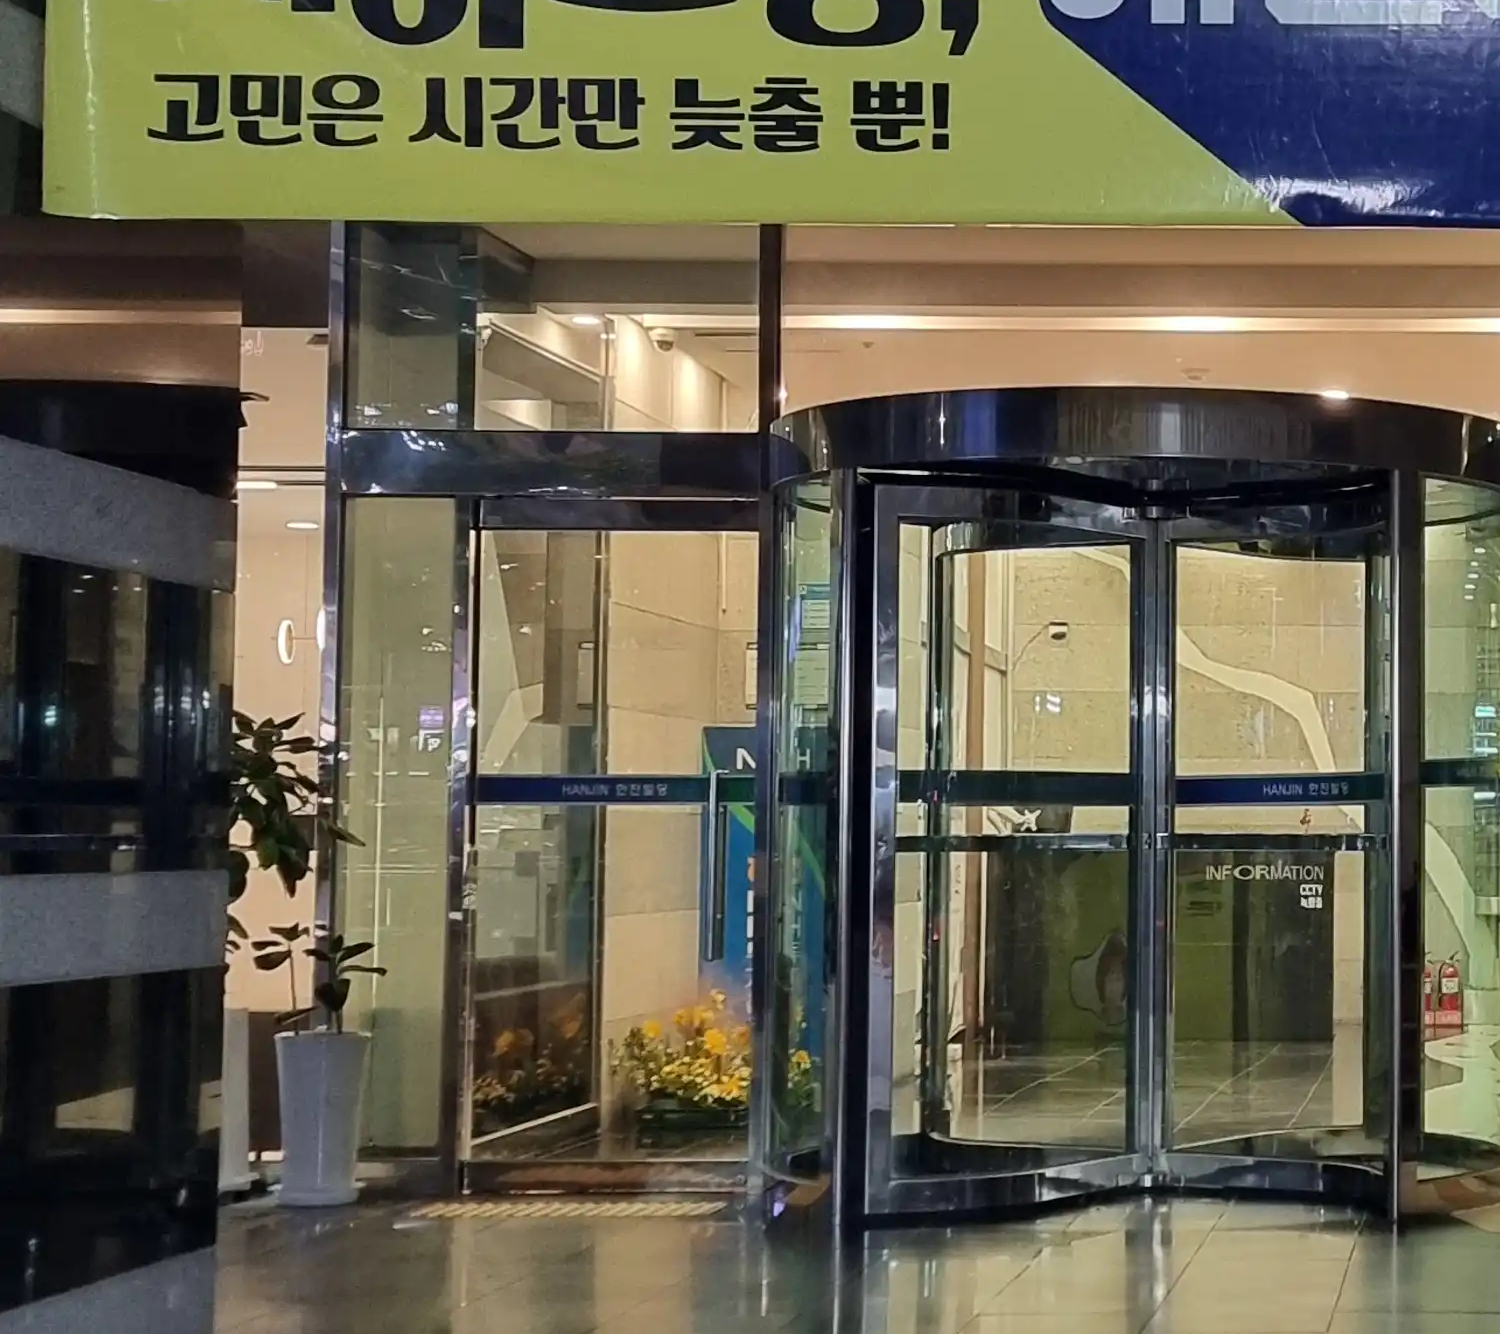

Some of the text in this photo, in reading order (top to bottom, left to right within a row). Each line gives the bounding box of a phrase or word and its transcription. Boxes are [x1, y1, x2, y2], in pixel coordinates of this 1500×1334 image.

[146, 73, 952, 153] 고민은 시간만 늦출 뿐!
[562, 784, 609, 798] HANJIN
[1263, 783, 1303, 796] HANJIN
[1206, 864, 1324, 881] INFORMATION
[1300, 883, 1323, 896] CCTV
